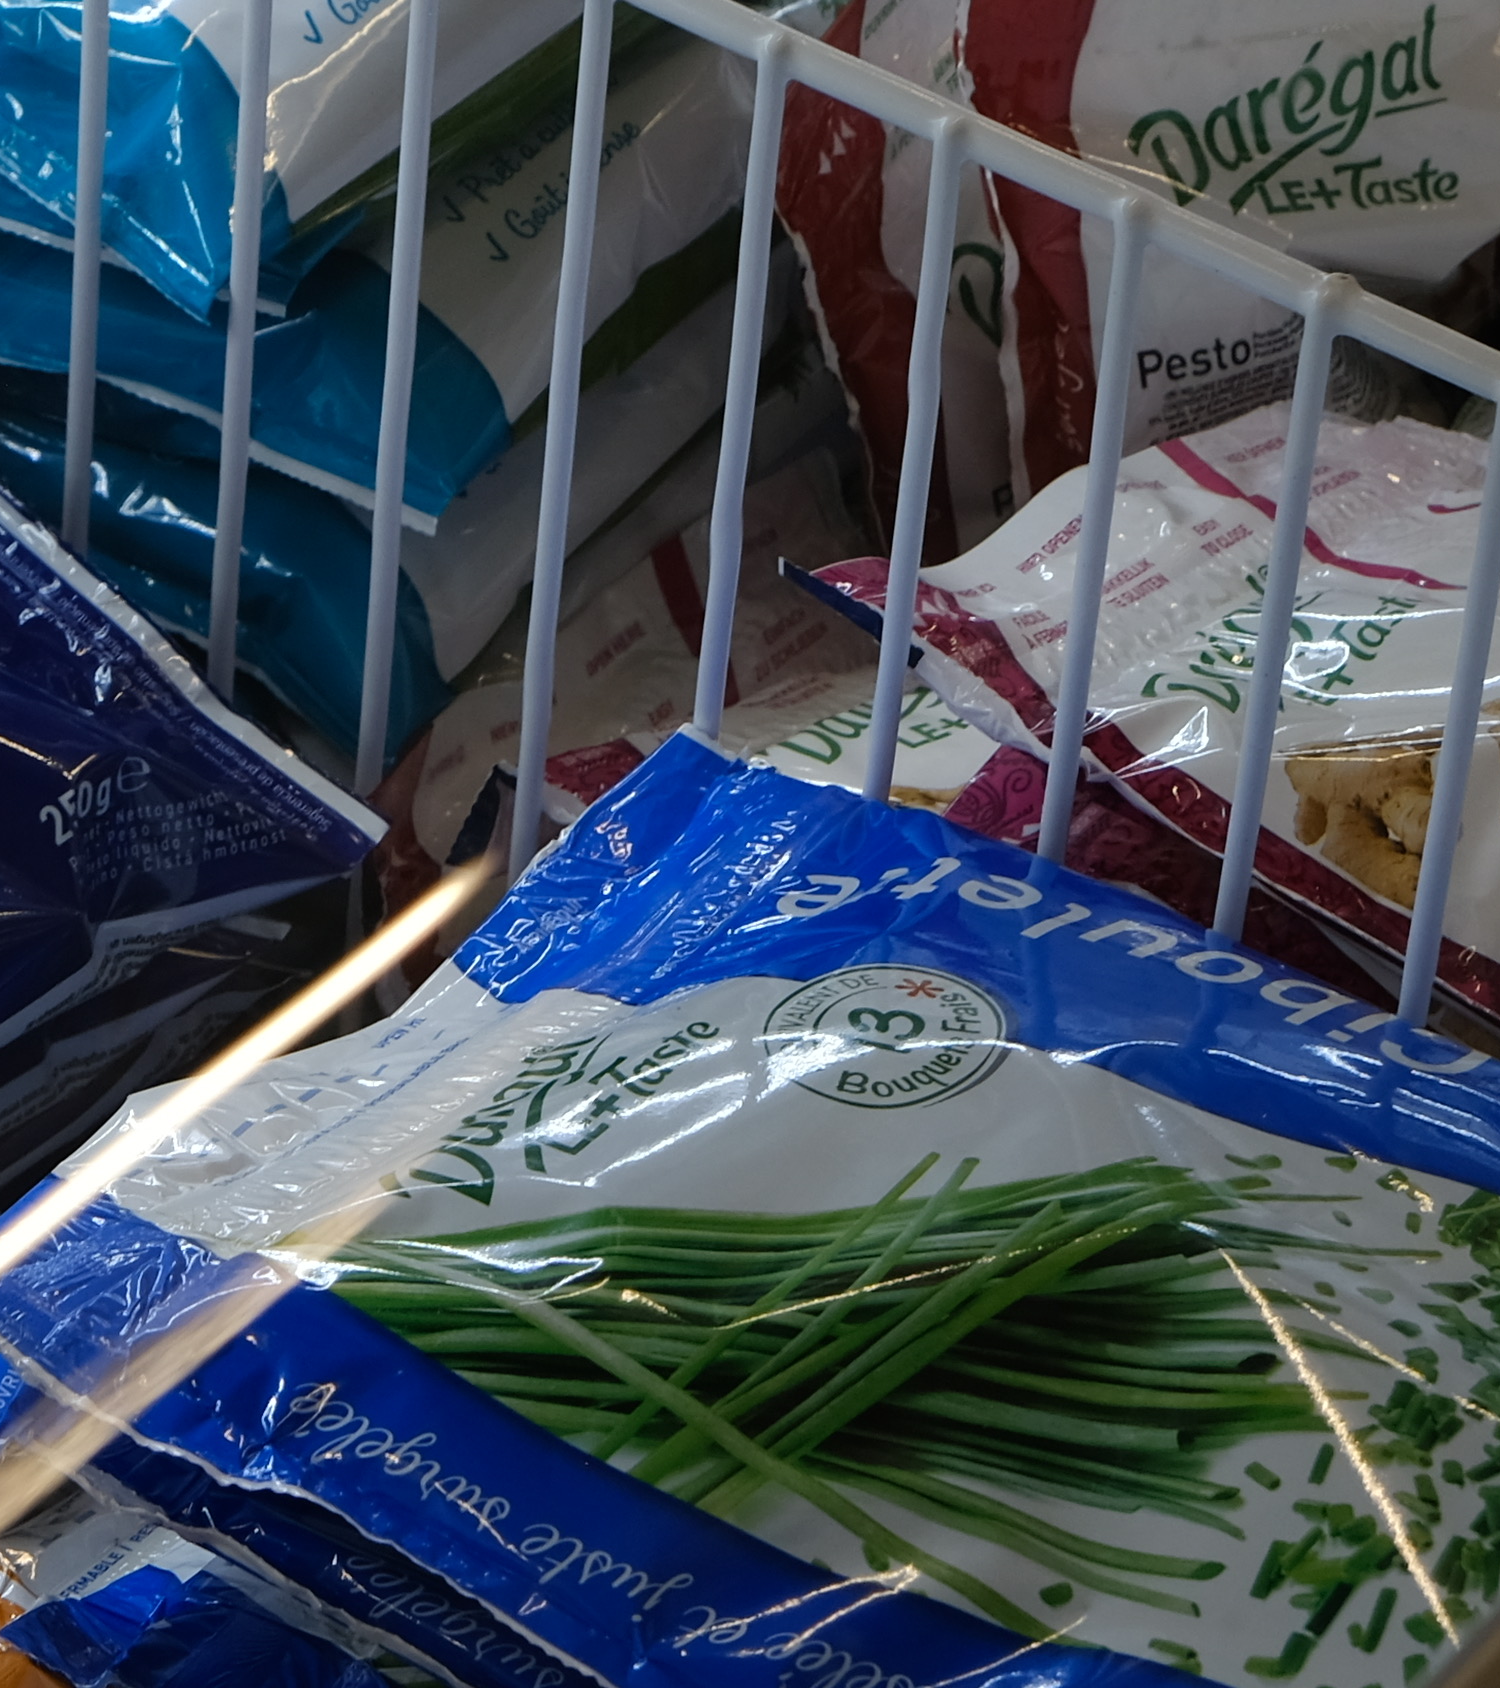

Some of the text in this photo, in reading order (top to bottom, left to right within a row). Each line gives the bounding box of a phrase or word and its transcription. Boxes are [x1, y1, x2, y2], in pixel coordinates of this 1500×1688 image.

[1126, 3, 1445, 209] Darégal
[1255, 159, 1462, 217] LE+Taste
[1136, 337, 1253, 390] Pesto
[1014, 551, 1046, 575] HIER
[1010, 609, 1051, 630] FACILE
[201, 827, 289, 861] hmotnost
[841, 973, 881, 990] DE
[519, 1523, 755, 1652] juste et
